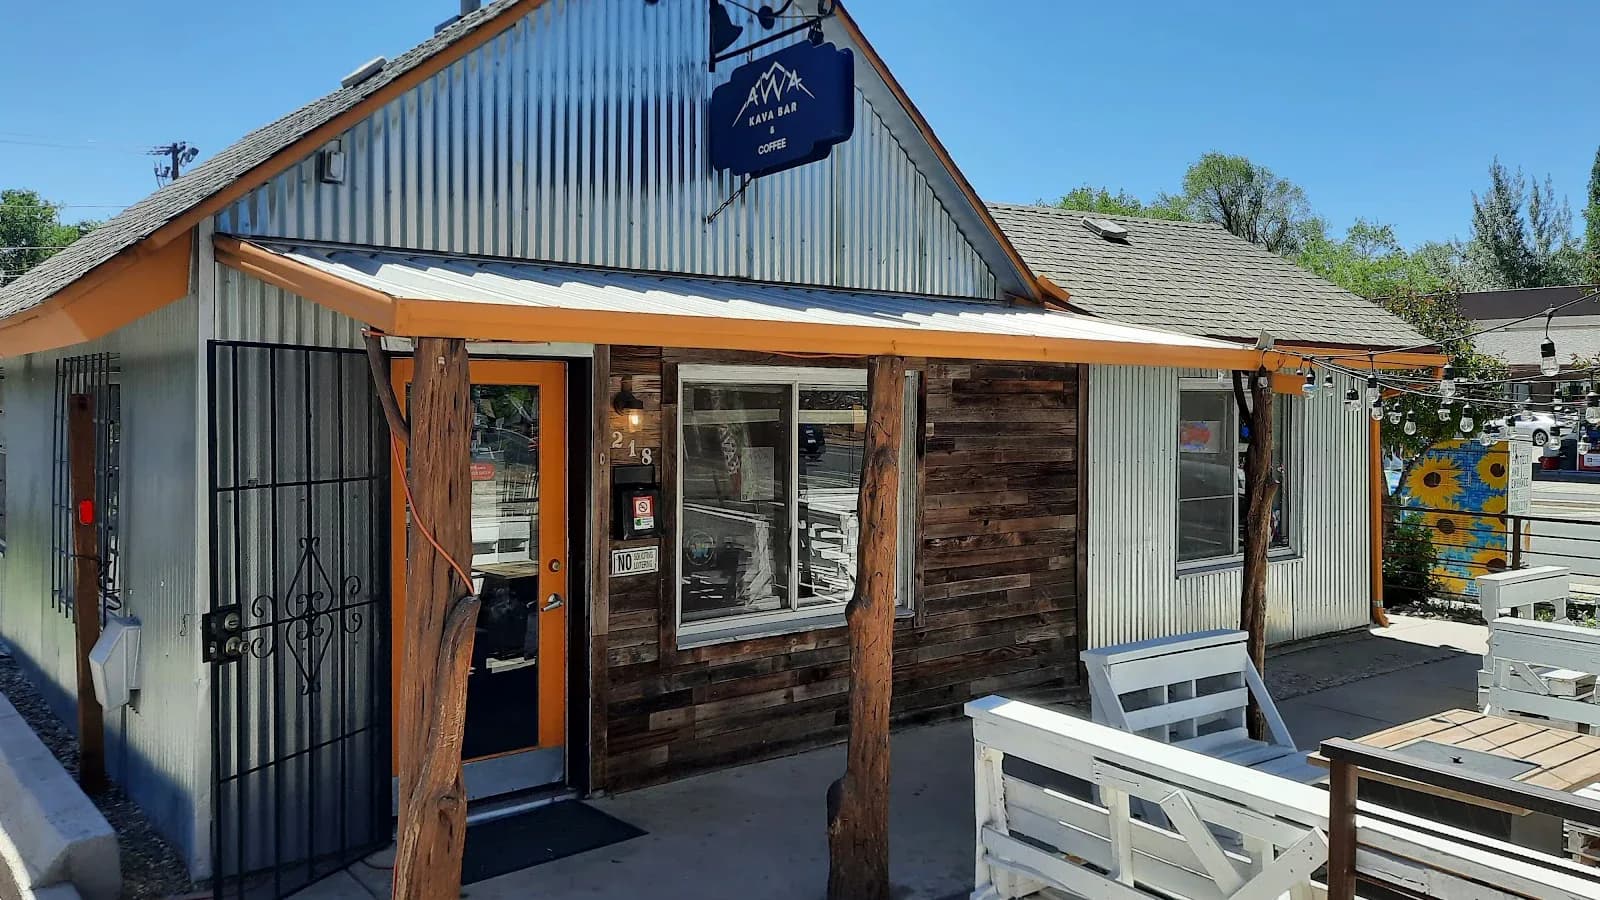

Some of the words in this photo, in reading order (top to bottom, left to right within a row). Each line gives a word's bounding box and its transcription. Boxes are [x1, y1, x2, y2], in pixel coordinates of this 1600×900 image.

[749, 110, 774, 126] KAVA
[777, 102, 797, 117] BAR
[758, 138, 787, 155] COFFEE
[617, 553, 632, 571] NO
